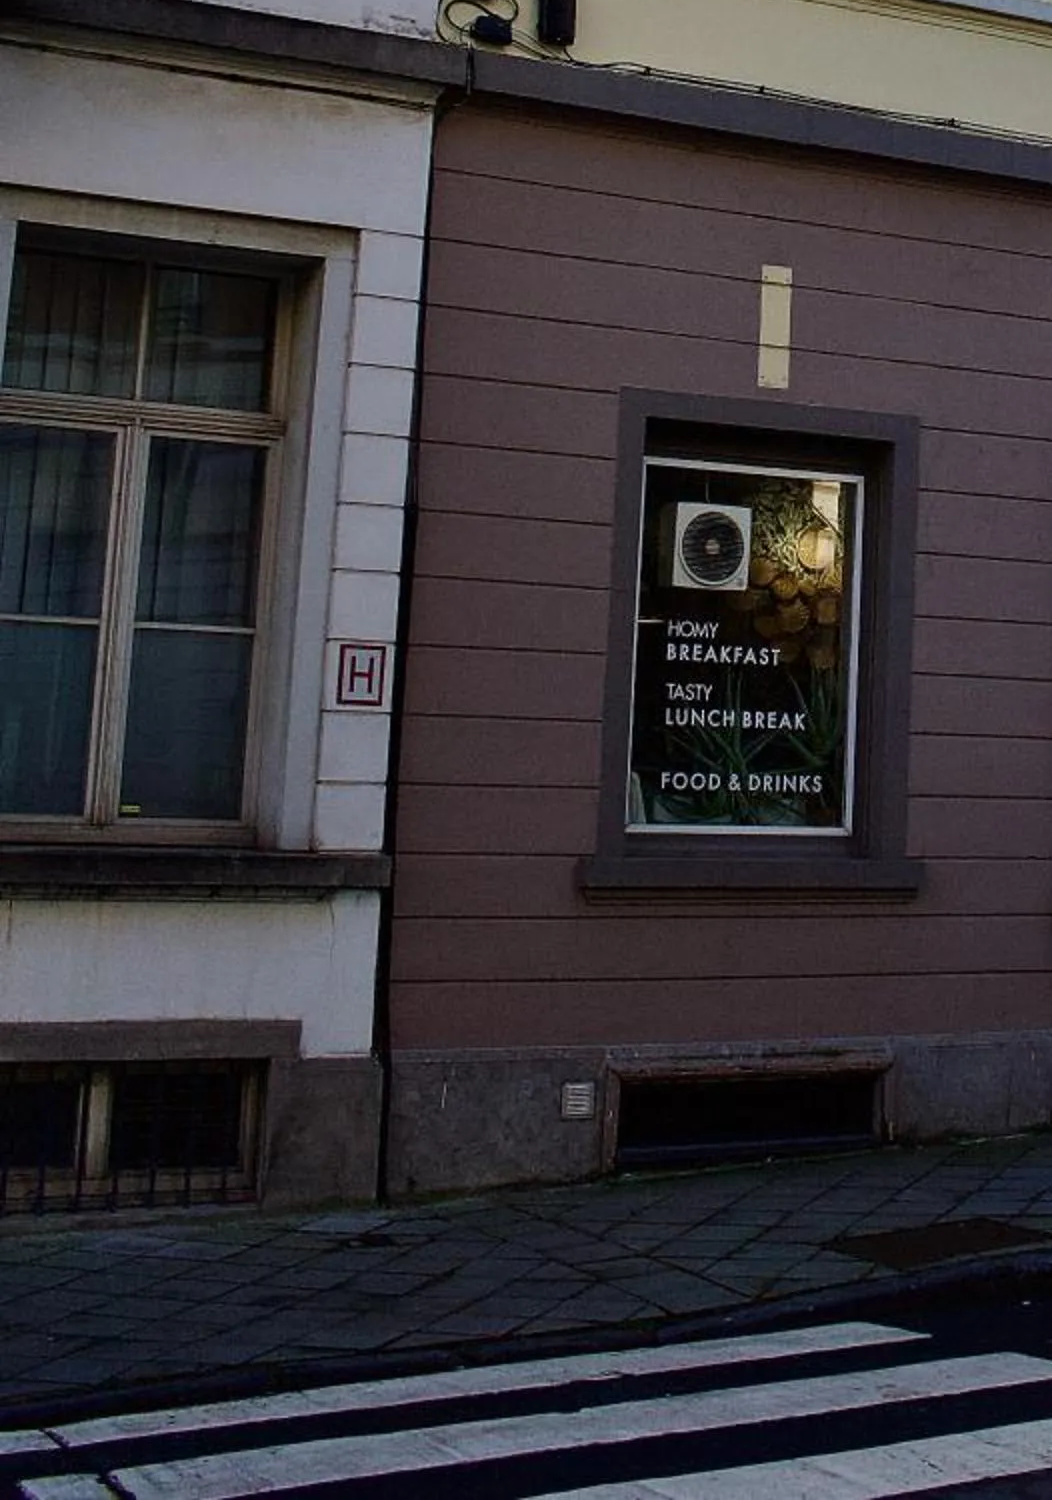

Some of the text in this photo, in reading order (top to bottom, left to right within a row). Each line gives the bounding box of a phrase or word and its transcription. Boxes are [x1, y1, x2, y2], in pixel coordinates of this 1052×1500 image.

[667, 620, 719, 639] HOMY
[667, 643, 781, 667] BREAKFAST
[349, 655, 375, 693] H
[666, 683, 713, 701] TASTY
[665, 707, 806, 731] LUNCH BREAK
[661, 771, 823, 793] FOOD & DRINKS
